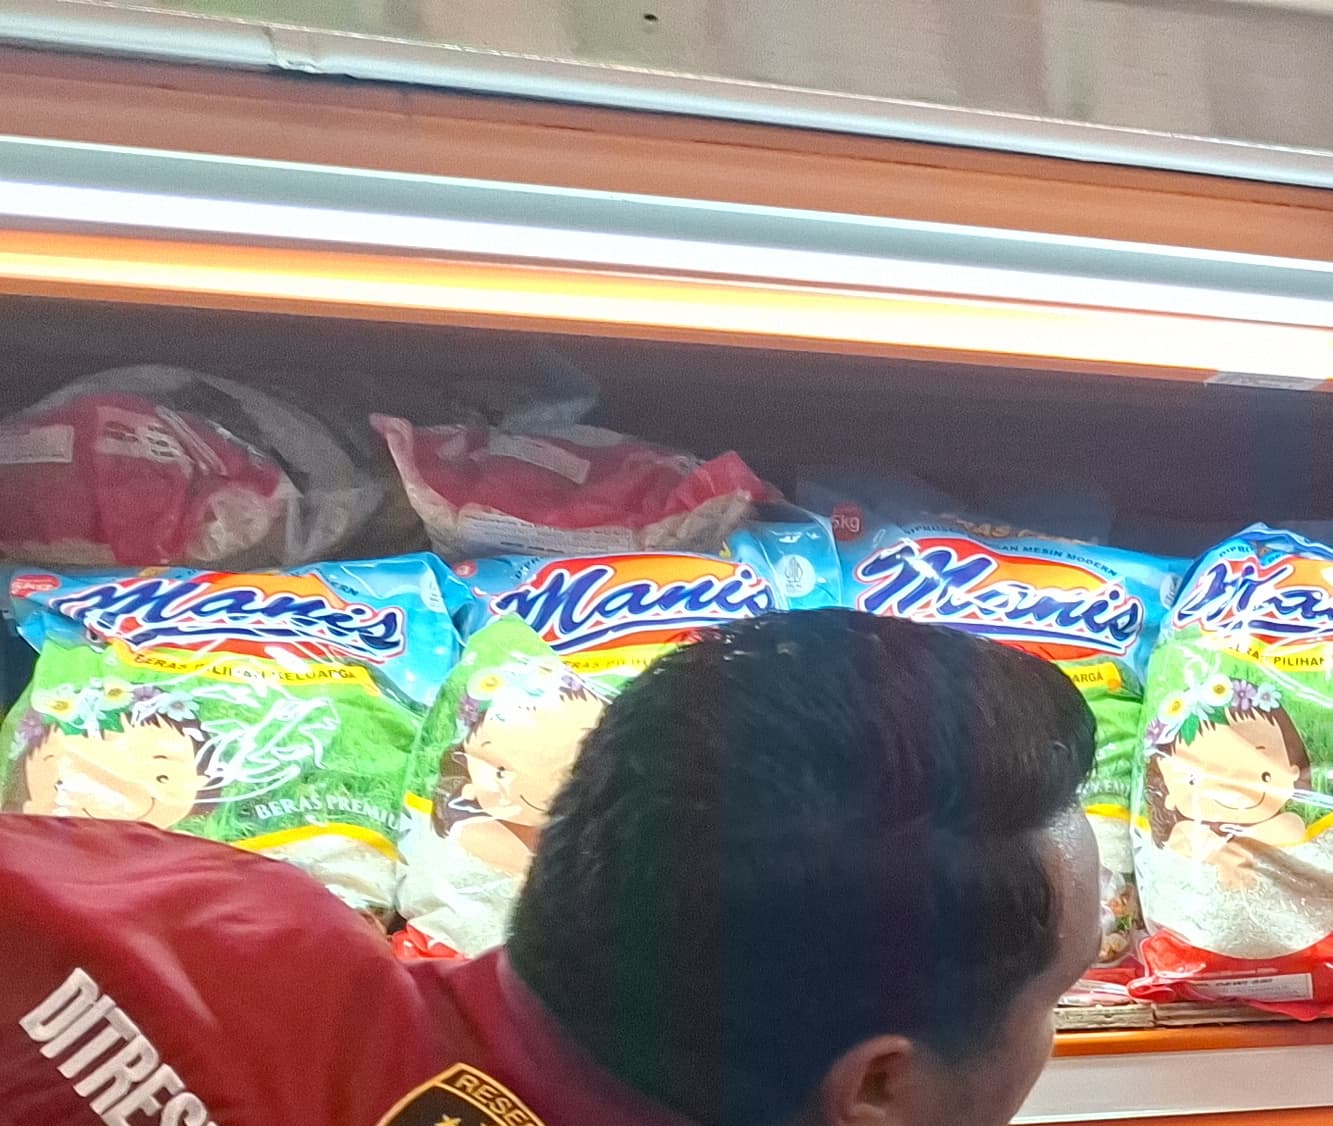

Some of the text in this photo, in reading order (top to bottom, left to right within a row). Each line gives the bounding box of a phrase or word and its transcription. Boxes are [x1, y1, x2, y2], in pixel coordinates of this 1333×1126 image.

[1066, 552, 1119, 578] MODERN
[50, 578, 404, 650] Manis
[862, 545, 1140, 642] Manis
[256, 797, 324, 820] BERAS
